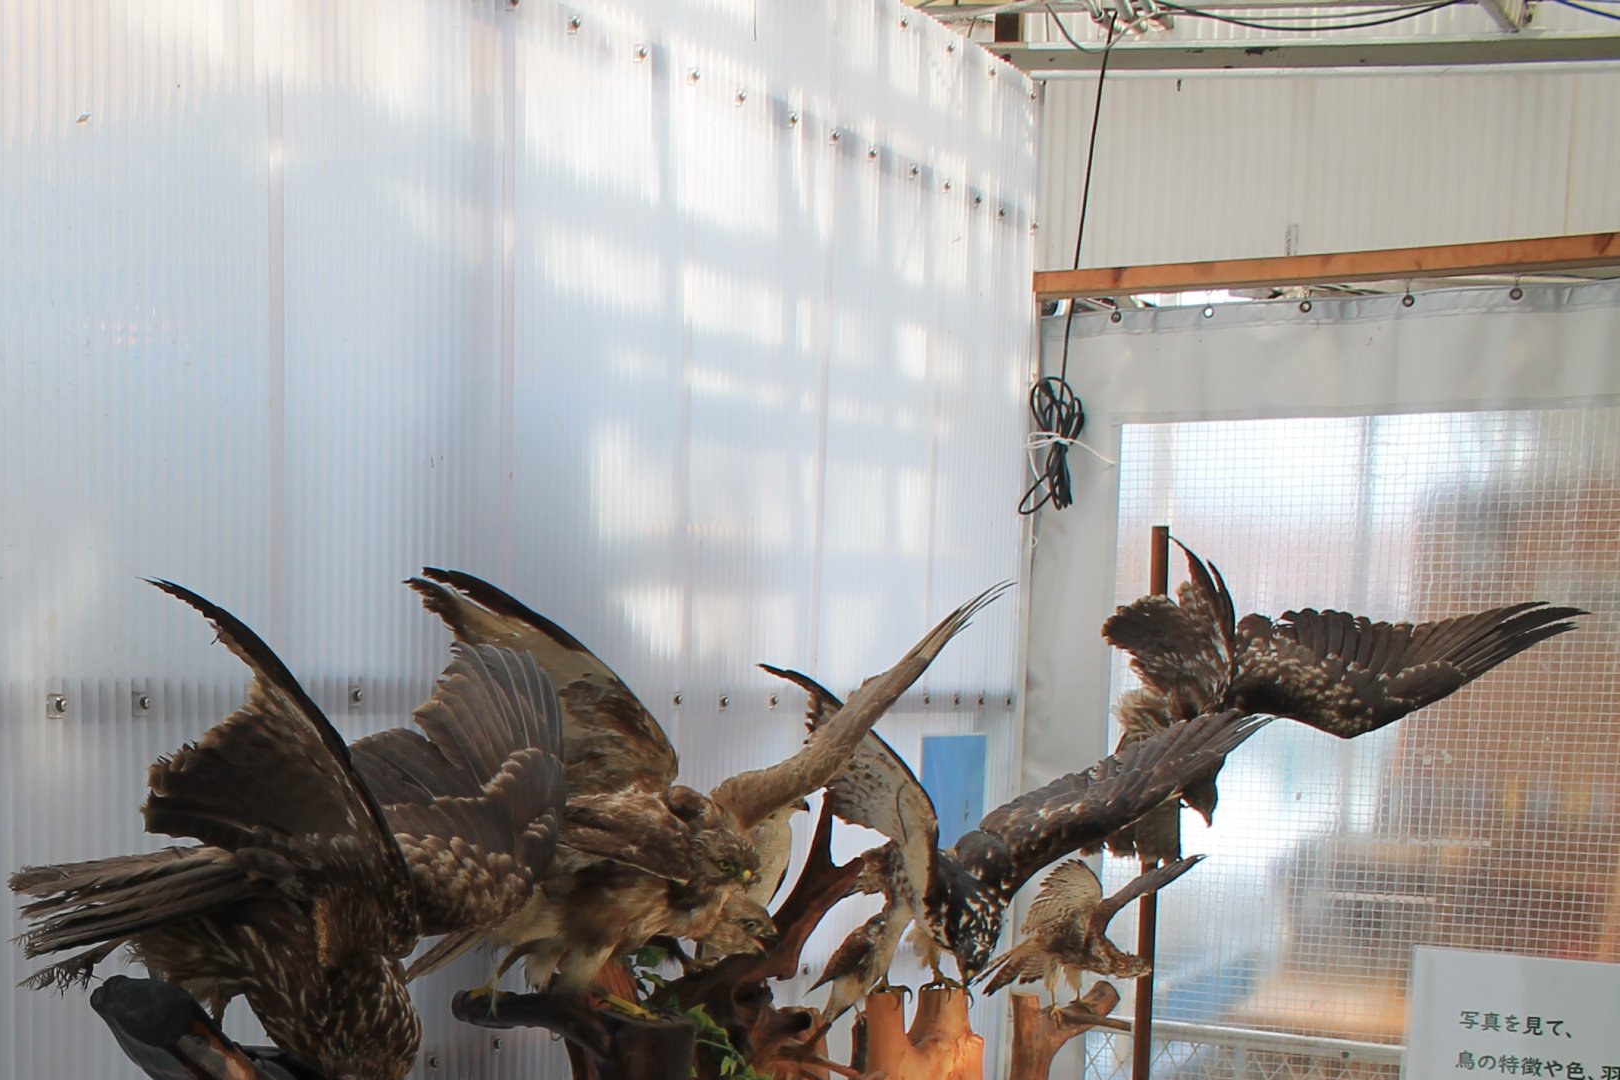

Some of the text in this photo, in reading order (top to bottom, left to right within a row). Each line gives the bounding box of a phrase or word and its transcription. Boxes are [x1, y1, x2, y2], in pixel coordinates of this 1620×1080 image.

[1459, 1010, 1573, 1039] 写真を見て、
